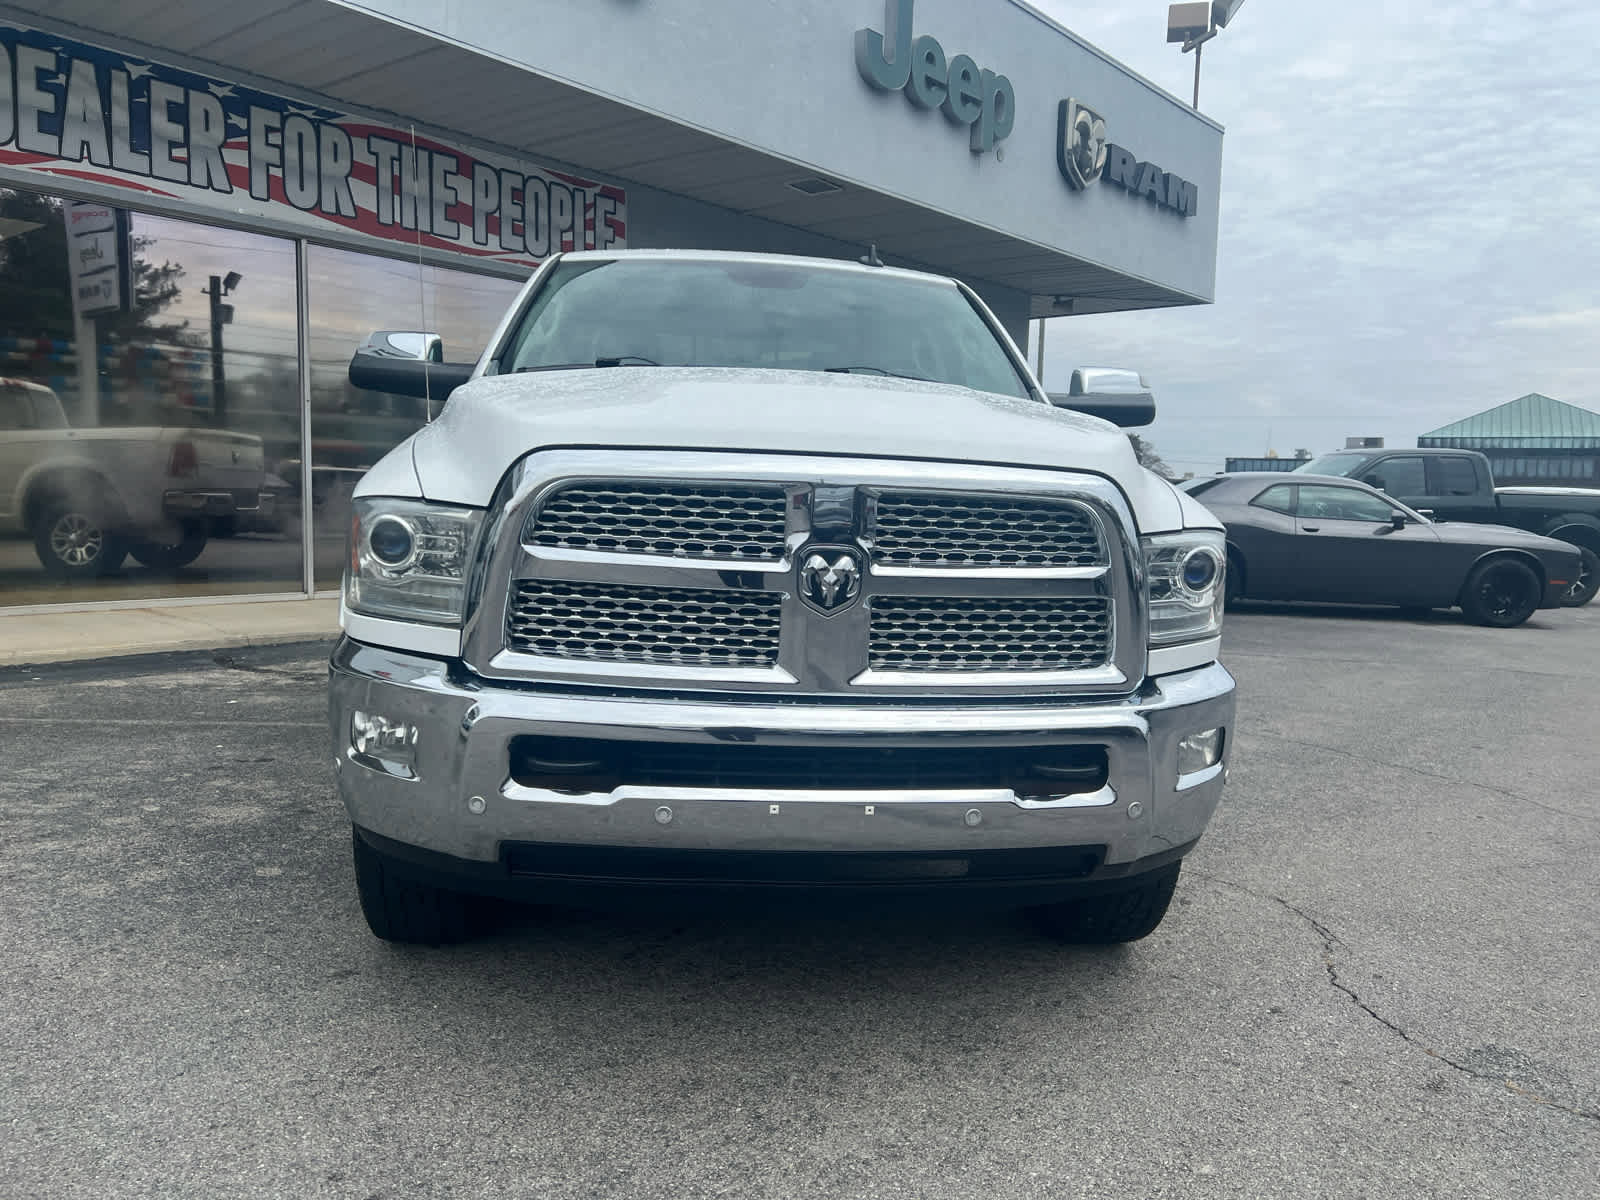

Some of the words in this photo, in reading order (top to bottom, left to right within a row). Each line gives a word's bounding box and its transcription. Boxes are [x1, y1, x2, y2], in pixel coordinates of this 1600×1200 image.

[854, 0, 1015, 153] Jeep
[247, 104, 358, 219] FOR
[367, 133, 460, 240] THE
[1101, 143, 1198, 217] RAM
